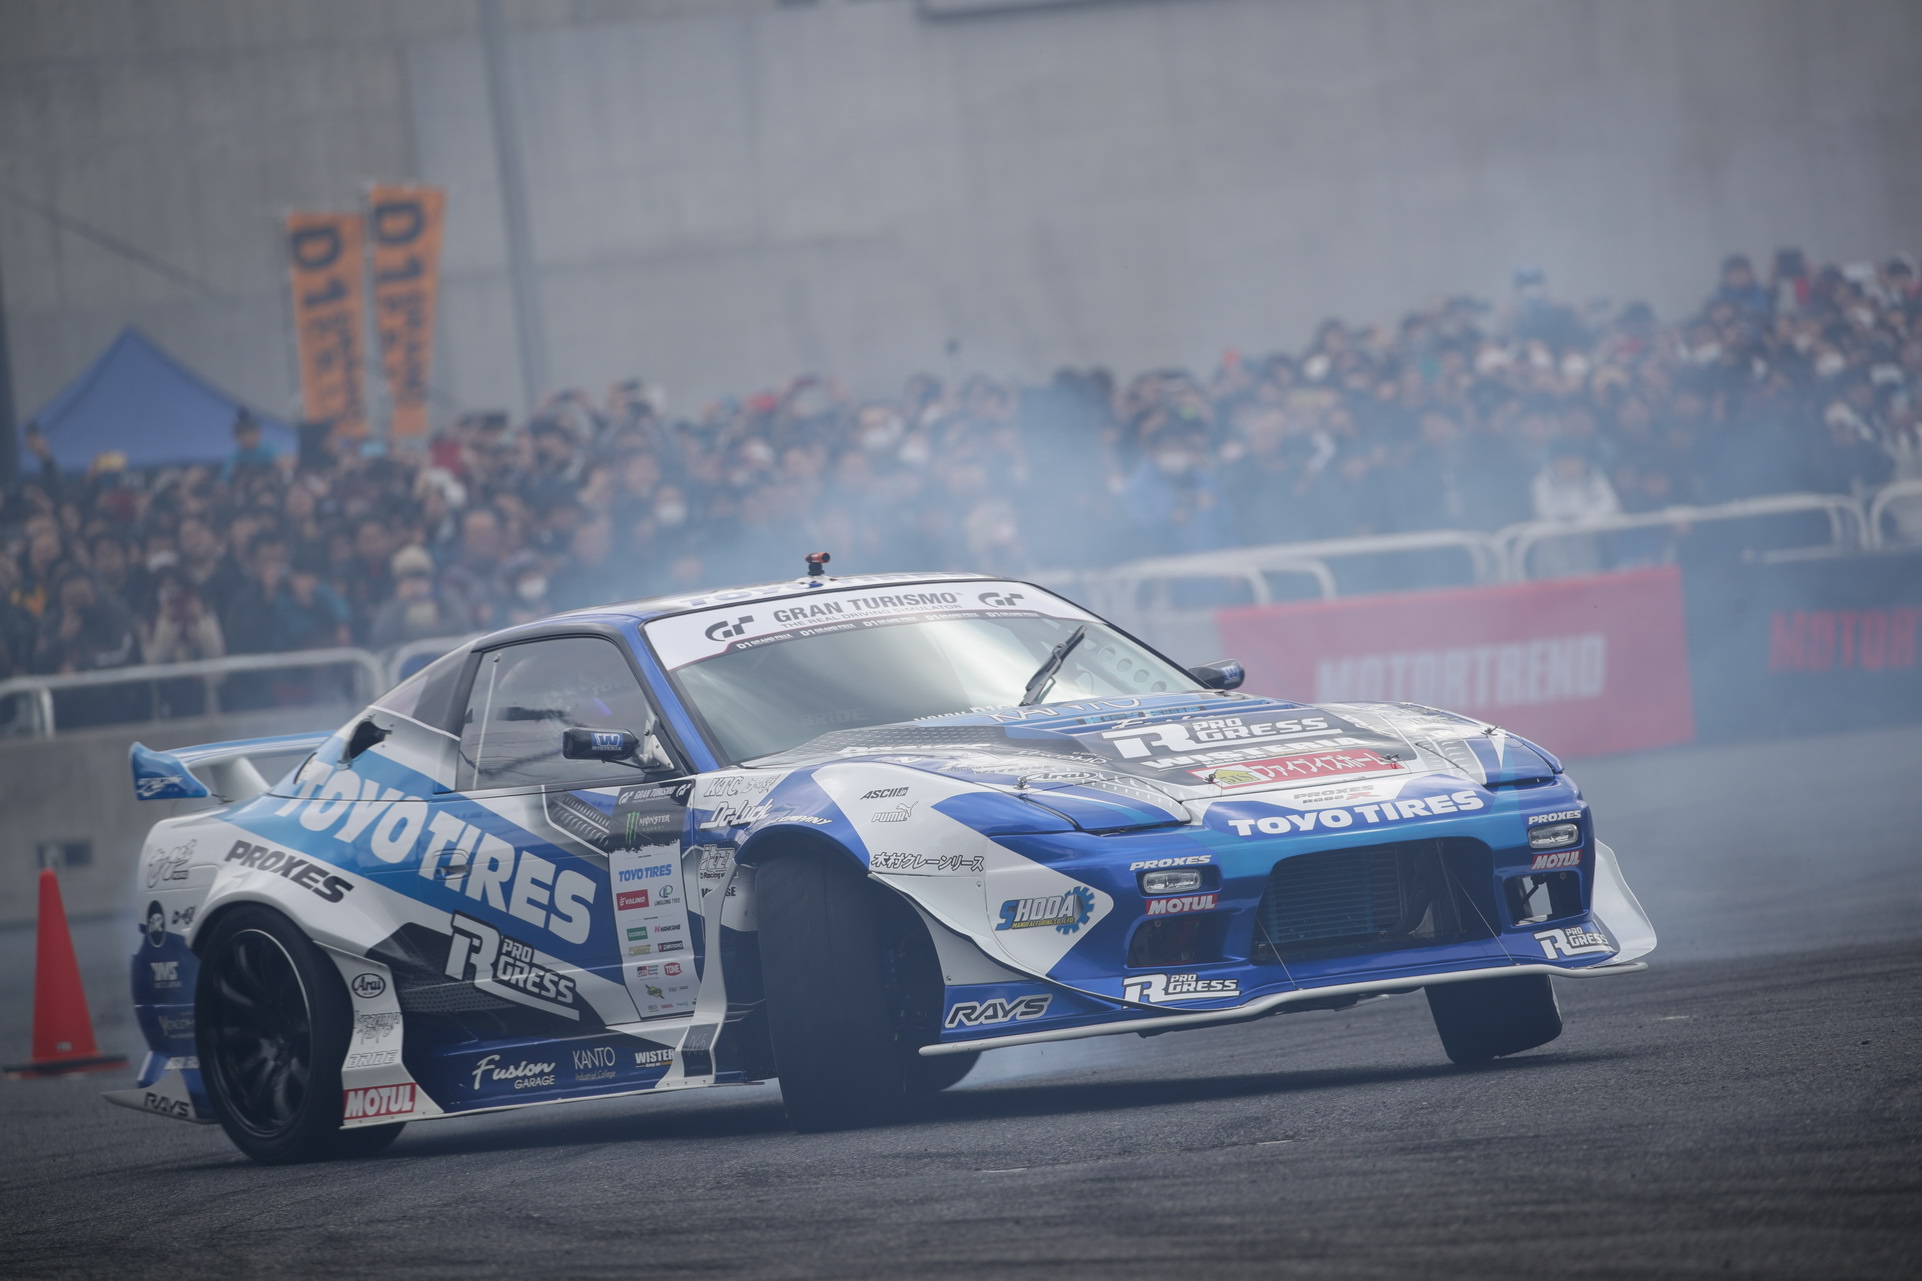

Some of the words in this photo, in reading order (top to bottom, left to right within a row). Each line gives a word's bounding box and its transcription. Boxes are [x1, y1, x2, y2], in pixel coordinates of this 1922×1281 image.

[773, 601, 845, 624] GRAN
[847, 591, 959, 612] TURISMO
[781, 620, 804, 629] THE
[805, 616, 837, 626] REAL
[895, 603, 963, 614] SIMULATOR
[1192, 717, 1243, 732] PRO
[1199, 716, 1329, 742] GRESS
[1140, 737, 1367, 768] WISTERIA
[703, 776, 745, 798] KTC
[1294, 784, 1375, 800] PROXES
[639, 814, 670, 826] MONSTER
[871, 812, 908, 823] PUMA
[1228, 808, 1353, 837] TOYO
[1347, 790, 1485, 824] TIRES
[1528, 810, 1582, 825] PROXES
[274, 761, 429, 864] TOYO
[419, 810, 597, 945] TIRES
[871, 852, 985, 872] 木村クレーンリース
[1130, 855, 1212, 871] PROXES
[1531, 851, 1582, 870] MOTUL
[224, 840, 354, 903] PROXES
[618, 868, 645, 882] TOYO
[644, 864, 673, 879] TIRES
[995, 894, 1074, 930] SHODA
[1147, 895, 1217, 915] MOTUL
[1565, 926, 1584, 936] PRO
[1568, 932, 1608, 947] GRESS
[502, 938, 534, 963] PRO
[498, 954, 575, 1004] GRESS
[665, 965, 681, 975] TONE
[1170, 973, 1197, 983] PRO
[1168, 979, 1238, 993] GRESS
[946, 995, 1052, 1027] RAYS
[346, 1050, 399, 1068] BRIDE
[573, 1047, 615, 1069] KANTO
[634, 1048, 675, 1064] WISTER
[472, 1055, 556, 1090] Fusion
[514, 1075, 555, 1090] GARAGE
[144, 1092, 190, 1118] RAYS
[345, 1085, 415, 1118] MOTUL
